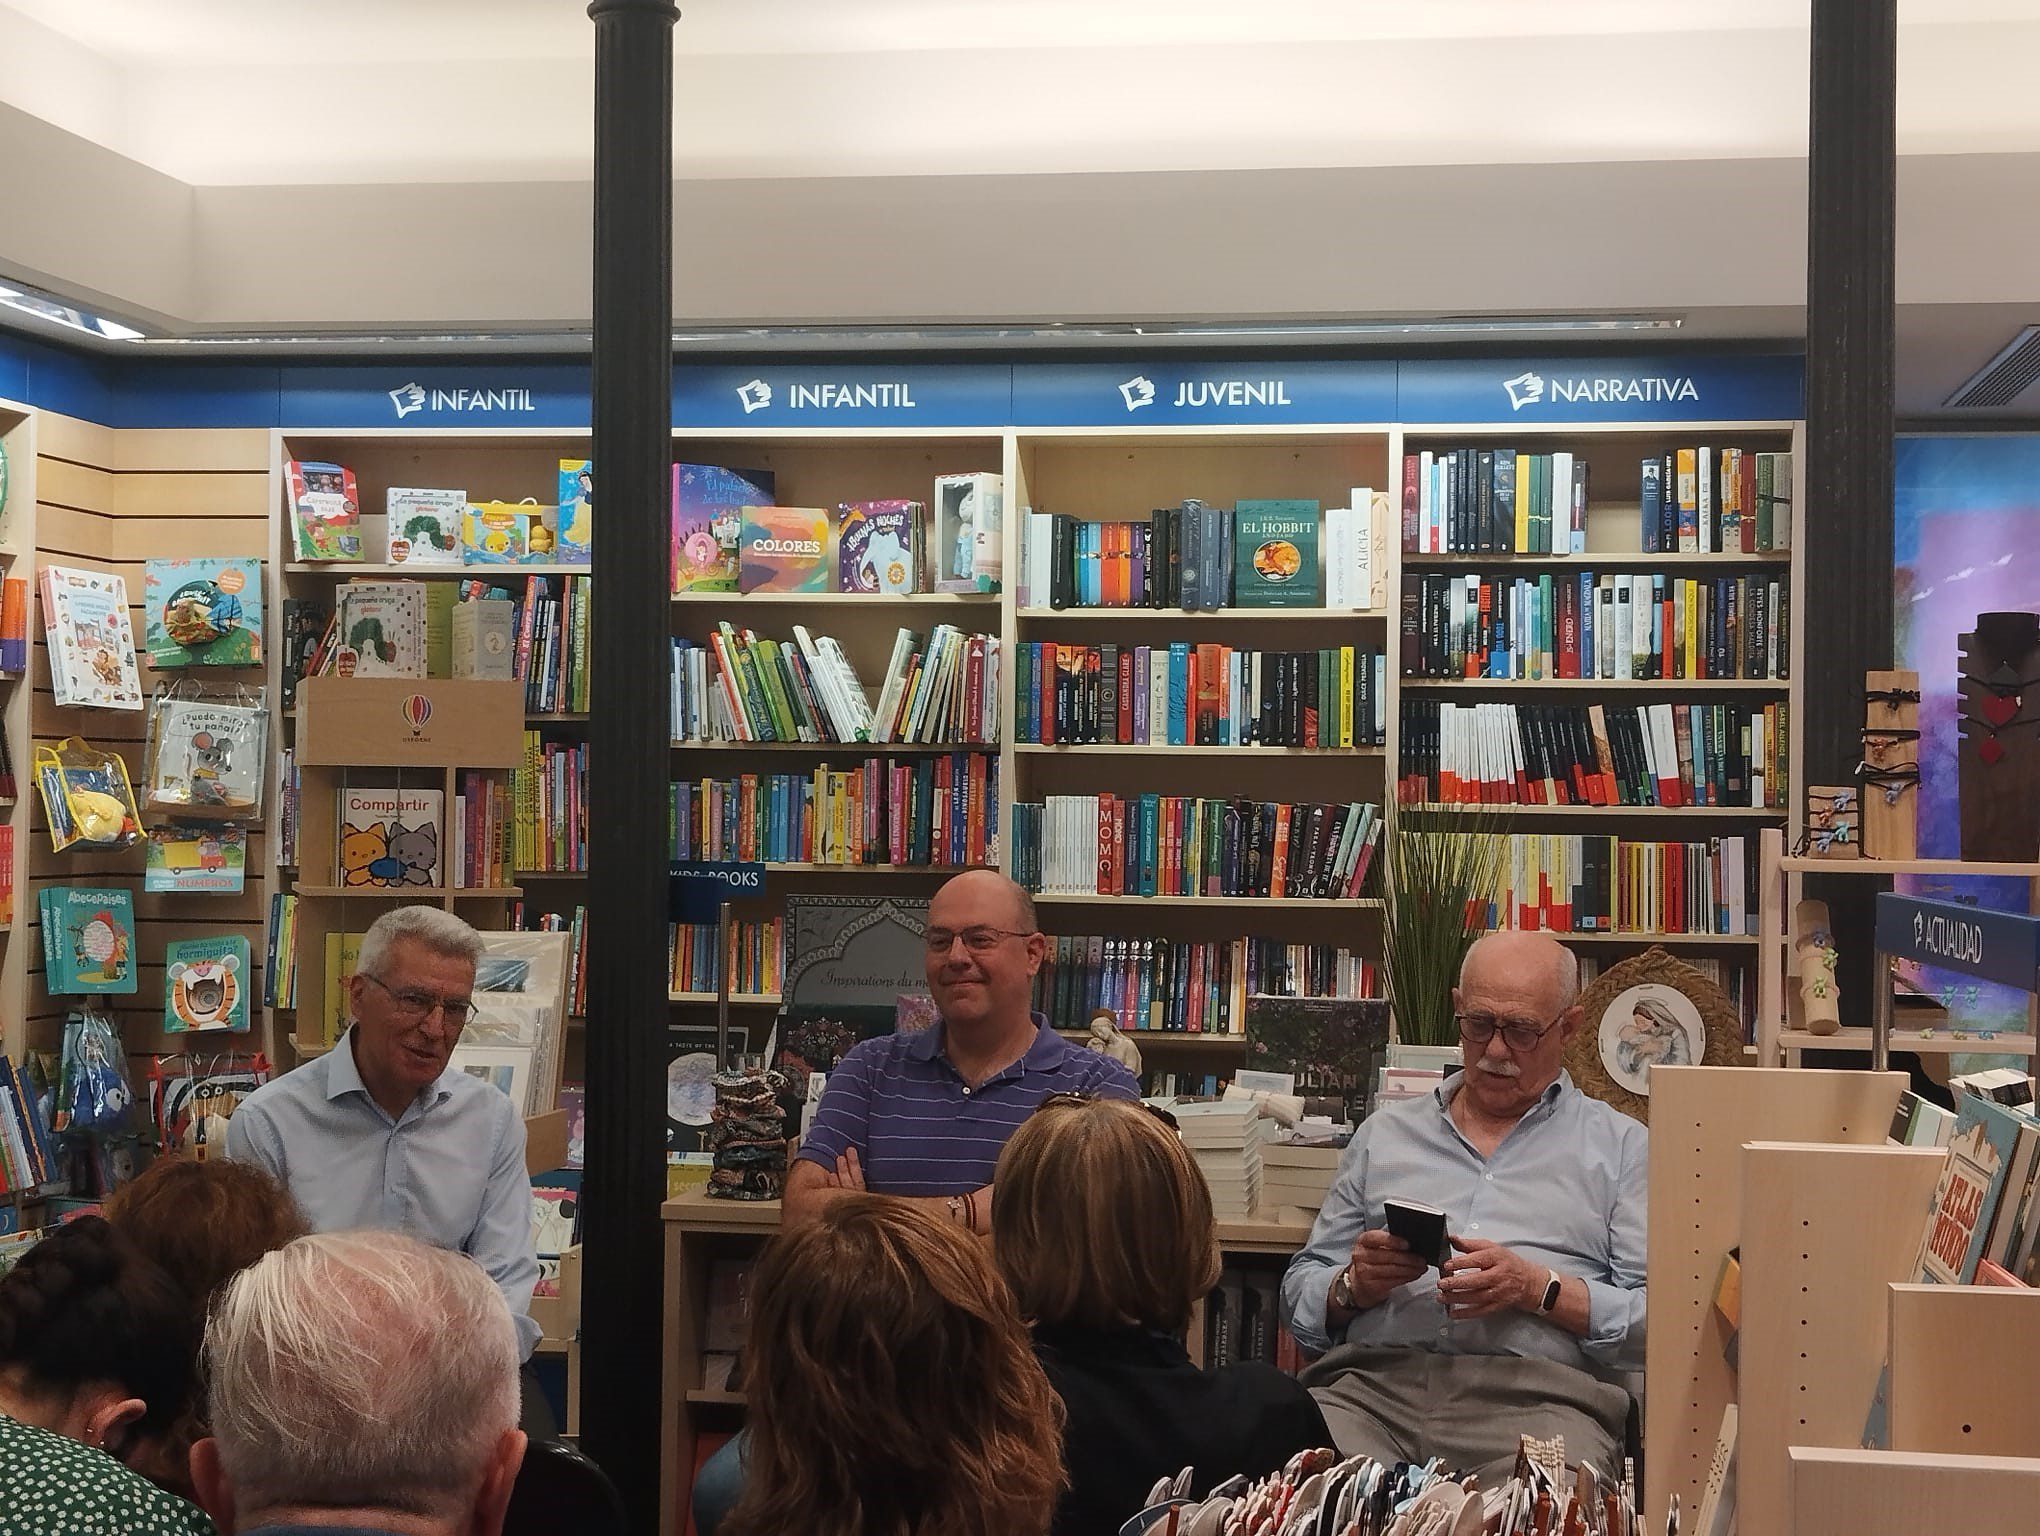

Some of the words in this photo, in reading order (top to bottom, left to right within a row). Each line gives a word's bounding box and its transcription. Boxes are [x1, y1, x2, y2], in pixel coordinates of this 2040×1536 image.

[431, 389, 535, 412] INFANTIL
[789, 383, 916, 409] INFANTIL
[1174, 381, 1292, 407] JUVENIL
[1550, 377, 1700, 403] NARRATIVA
[1243, 522, 1260, 534] EL
[1262, 522, 1314, 534] HOBBIT
[752, 539, 821, 554] COLORES
[1357, 528, 1369, 570] ALICIA
[576, 595, 586, 627] OBRAS
[575, 628, 586, 670] GRANDES
[350, 798, 431, 814] Compartir
[1925, 915, 1983, 964] ACTUALIDAD
[897, 970, 912, 987] du
[1941, 1173, 1984, 1233] ATLAS
[1929, 1211, 1971, 1276] MUNDO
